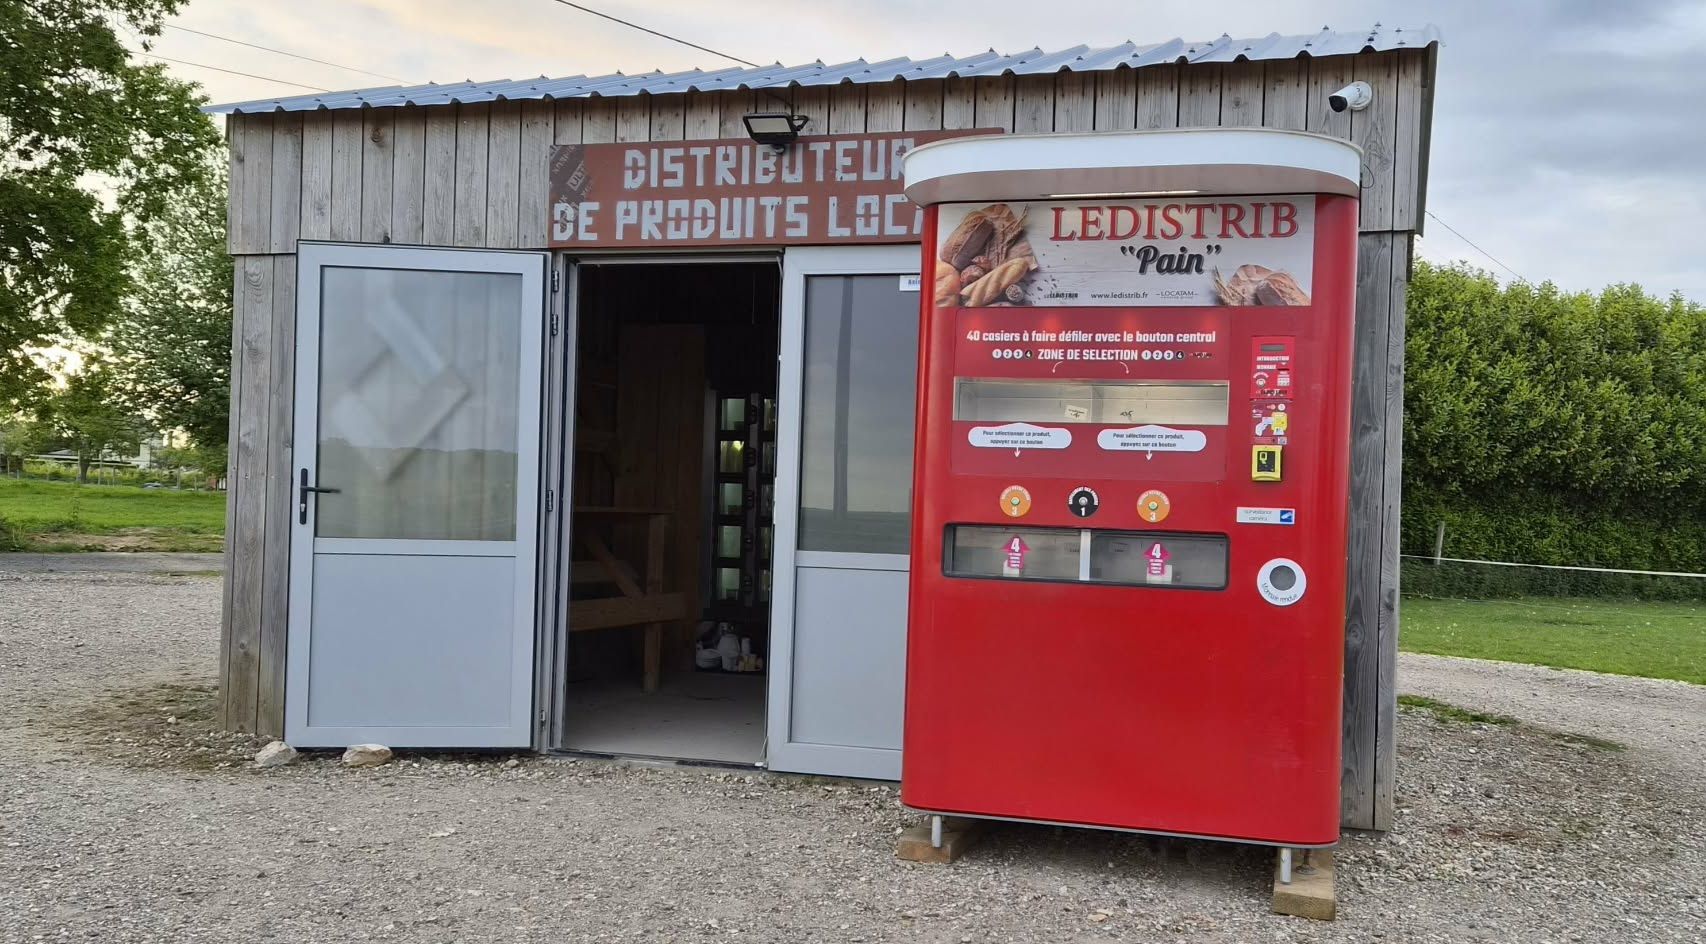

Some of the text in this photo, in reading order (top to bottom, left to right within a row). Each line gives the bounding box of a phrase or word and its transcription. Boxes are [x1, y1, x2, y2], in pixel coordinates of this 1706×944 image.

[553, 201, 600, 241] DE
[615, 195, 809, 241] PRODUITS
[1049, 202, 1299, 242] LEDISTRIB
[1090, 291, 1149, 300] www.ledistrib.fr
[966, 330, 1216, 343] 40 casiers à faire défiler avec le bouton central
[1037, 348, 1065, 360] ZONE
[1066, 349, 1081, 360] DE
[1082, 349, 1138, 361] SELECTION
[1080, 507, 1086, 517] 1
[1010, 537, 1020, 553] 4
[1151, 543, 1162, 559] 4
